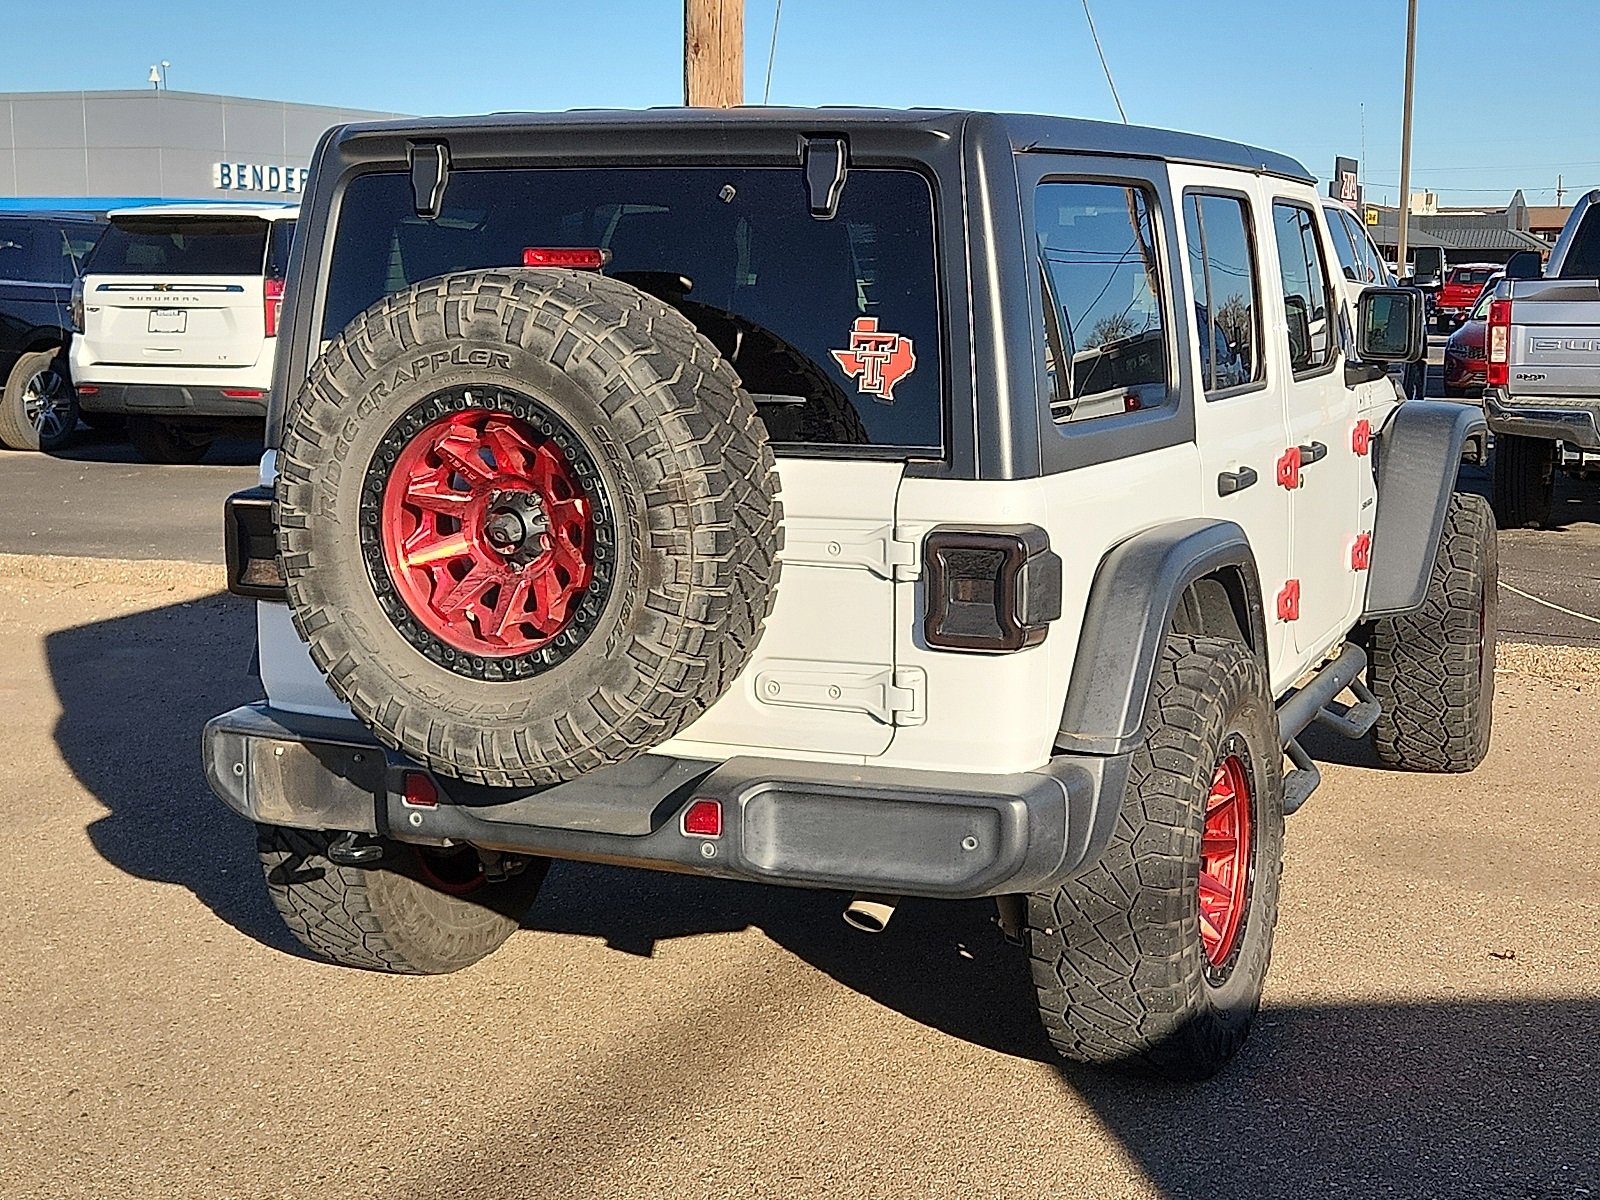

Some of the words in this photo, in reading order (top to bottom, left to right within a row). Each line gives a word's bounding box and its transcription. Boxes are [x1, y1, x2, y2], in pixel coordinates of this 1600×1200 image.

[1535, 341, 1600, 351] SU
[320, 416, 359, 524] RIDGE
[356, 345, 511, 416] GRAPPLER
